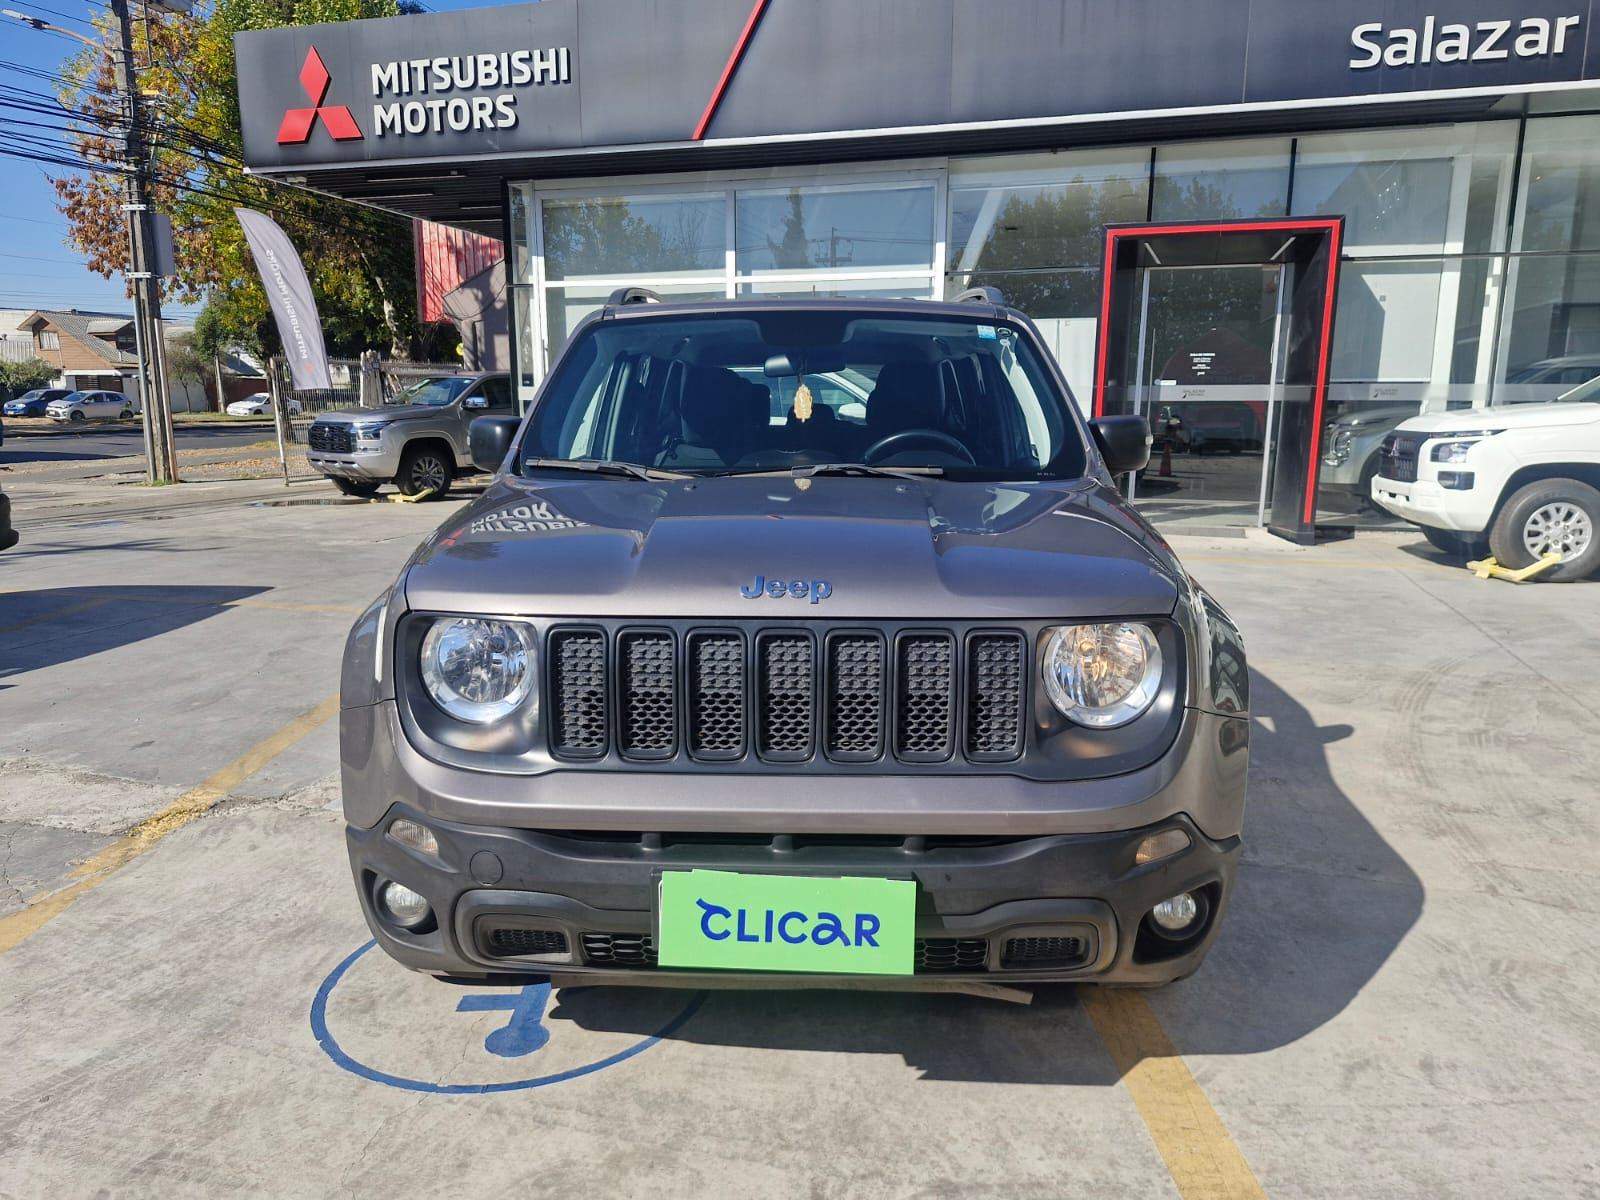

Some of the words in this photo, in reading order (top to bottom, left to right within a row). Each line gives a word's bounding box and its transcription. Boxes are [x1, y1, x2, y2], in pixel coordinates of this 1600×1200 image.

[1349, 15, 1580, 69] Salazar
[371, 47, 571, 96] MITSUBISHI
[373, 94, 519, 136] MOTORS
[740, 575, 833, 604] Jeep
